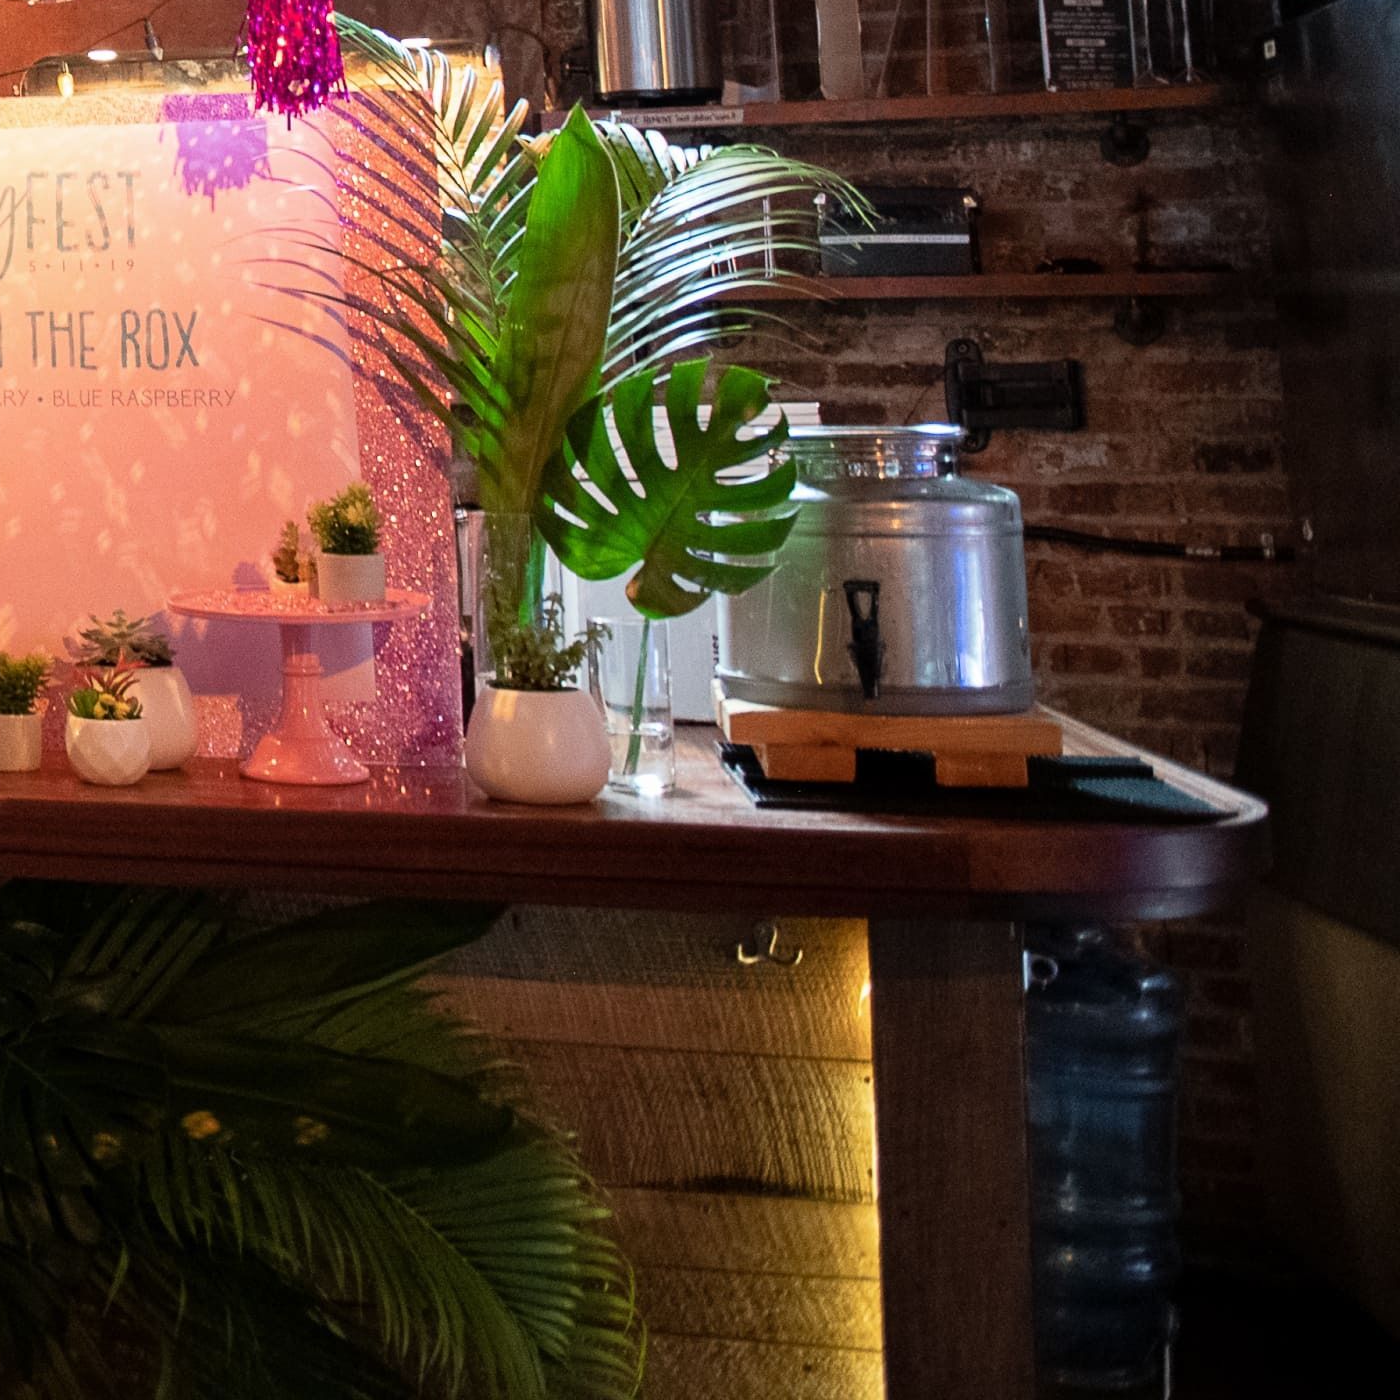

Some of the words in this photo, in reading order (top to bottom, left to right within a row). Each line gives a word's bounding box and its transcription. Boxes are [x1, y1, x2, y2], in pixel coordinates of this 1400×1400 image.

[25, 310, 98, 370] THE
[119, 309, 201, 370] ROX
[53, 389, 103, 407] BLUE
[111, 389, 236, 407] RASPBERRY
